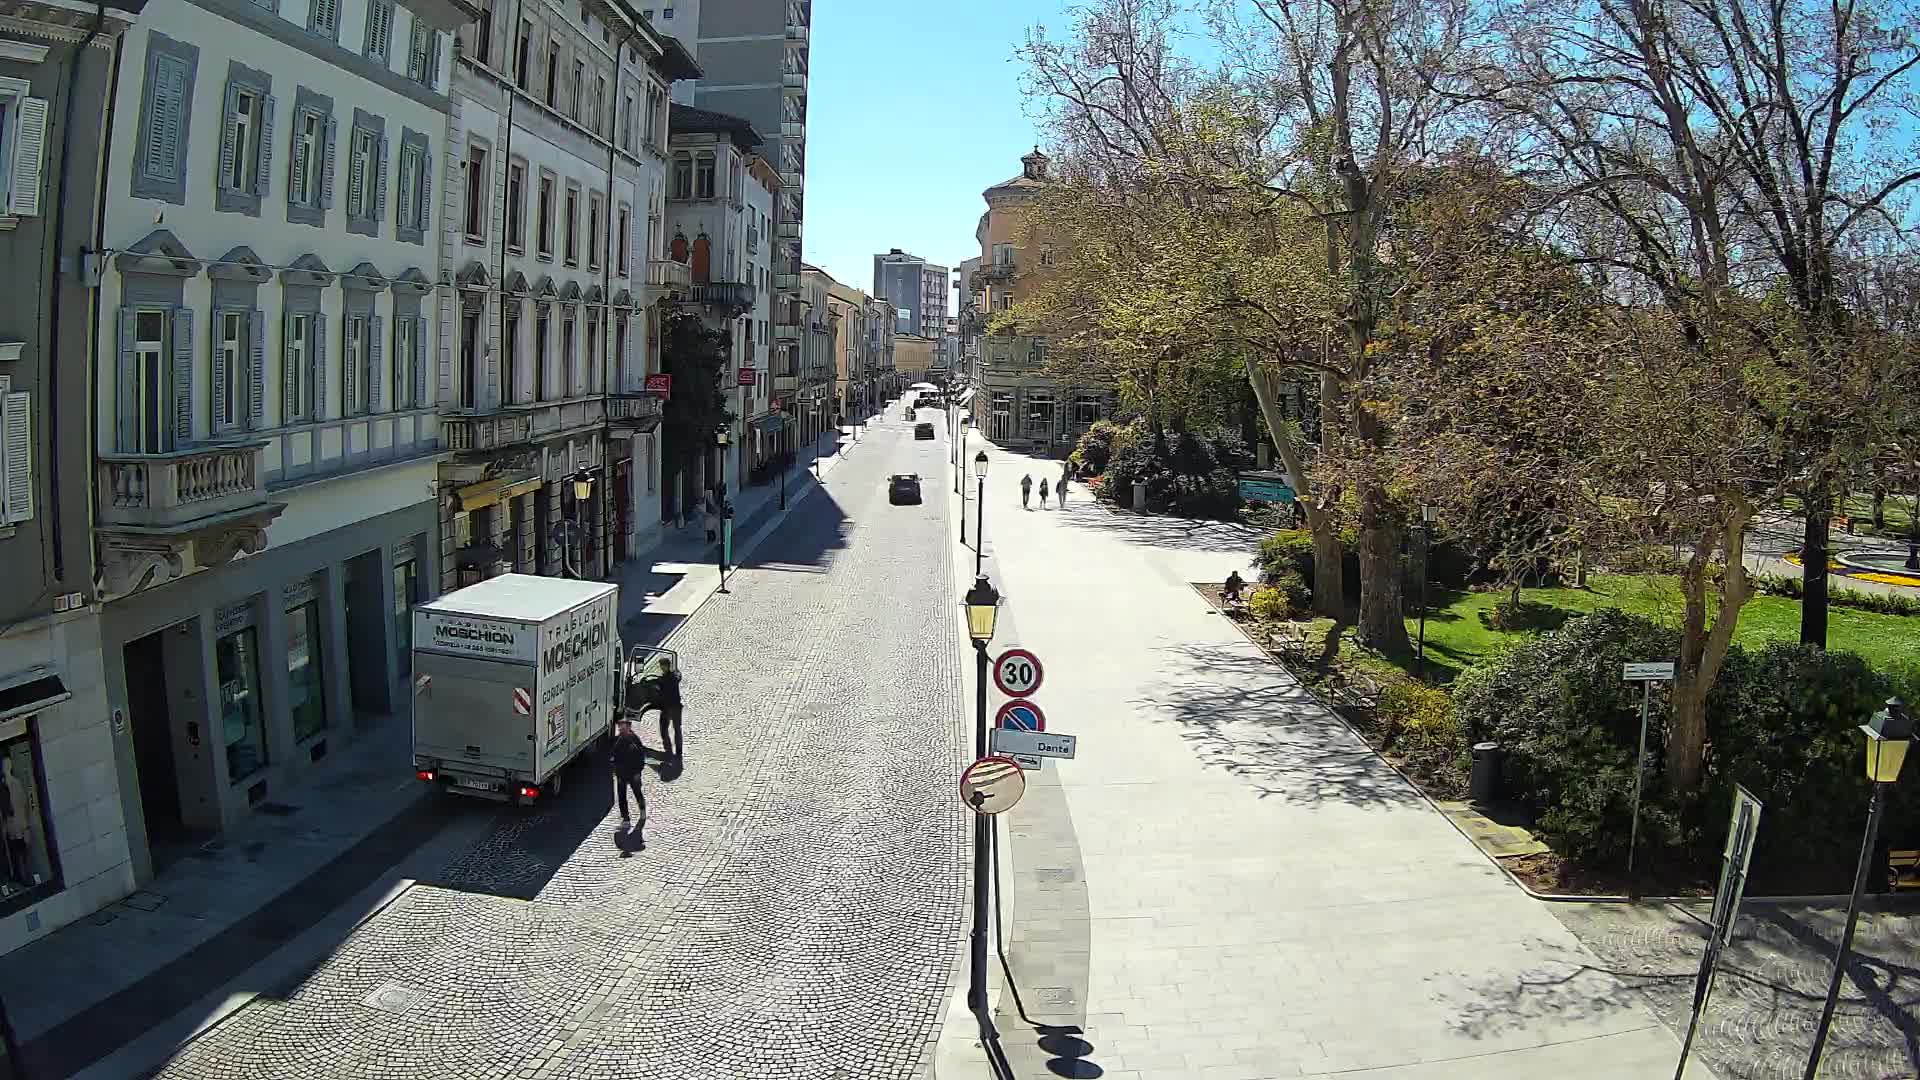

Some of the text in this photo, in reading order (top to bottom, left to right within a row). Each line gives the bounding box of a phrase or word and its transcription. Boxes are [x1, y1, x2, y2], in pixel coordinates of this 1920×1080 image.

[548, 603, 608, 640] TRASLOCHI
[436, 625, 514, 644] MOSCHION
[543, 621, 608, 678] MOSCHION
[1005, 663, 1032, 685] 30
[1037, 742, 1069, 754] Dante
